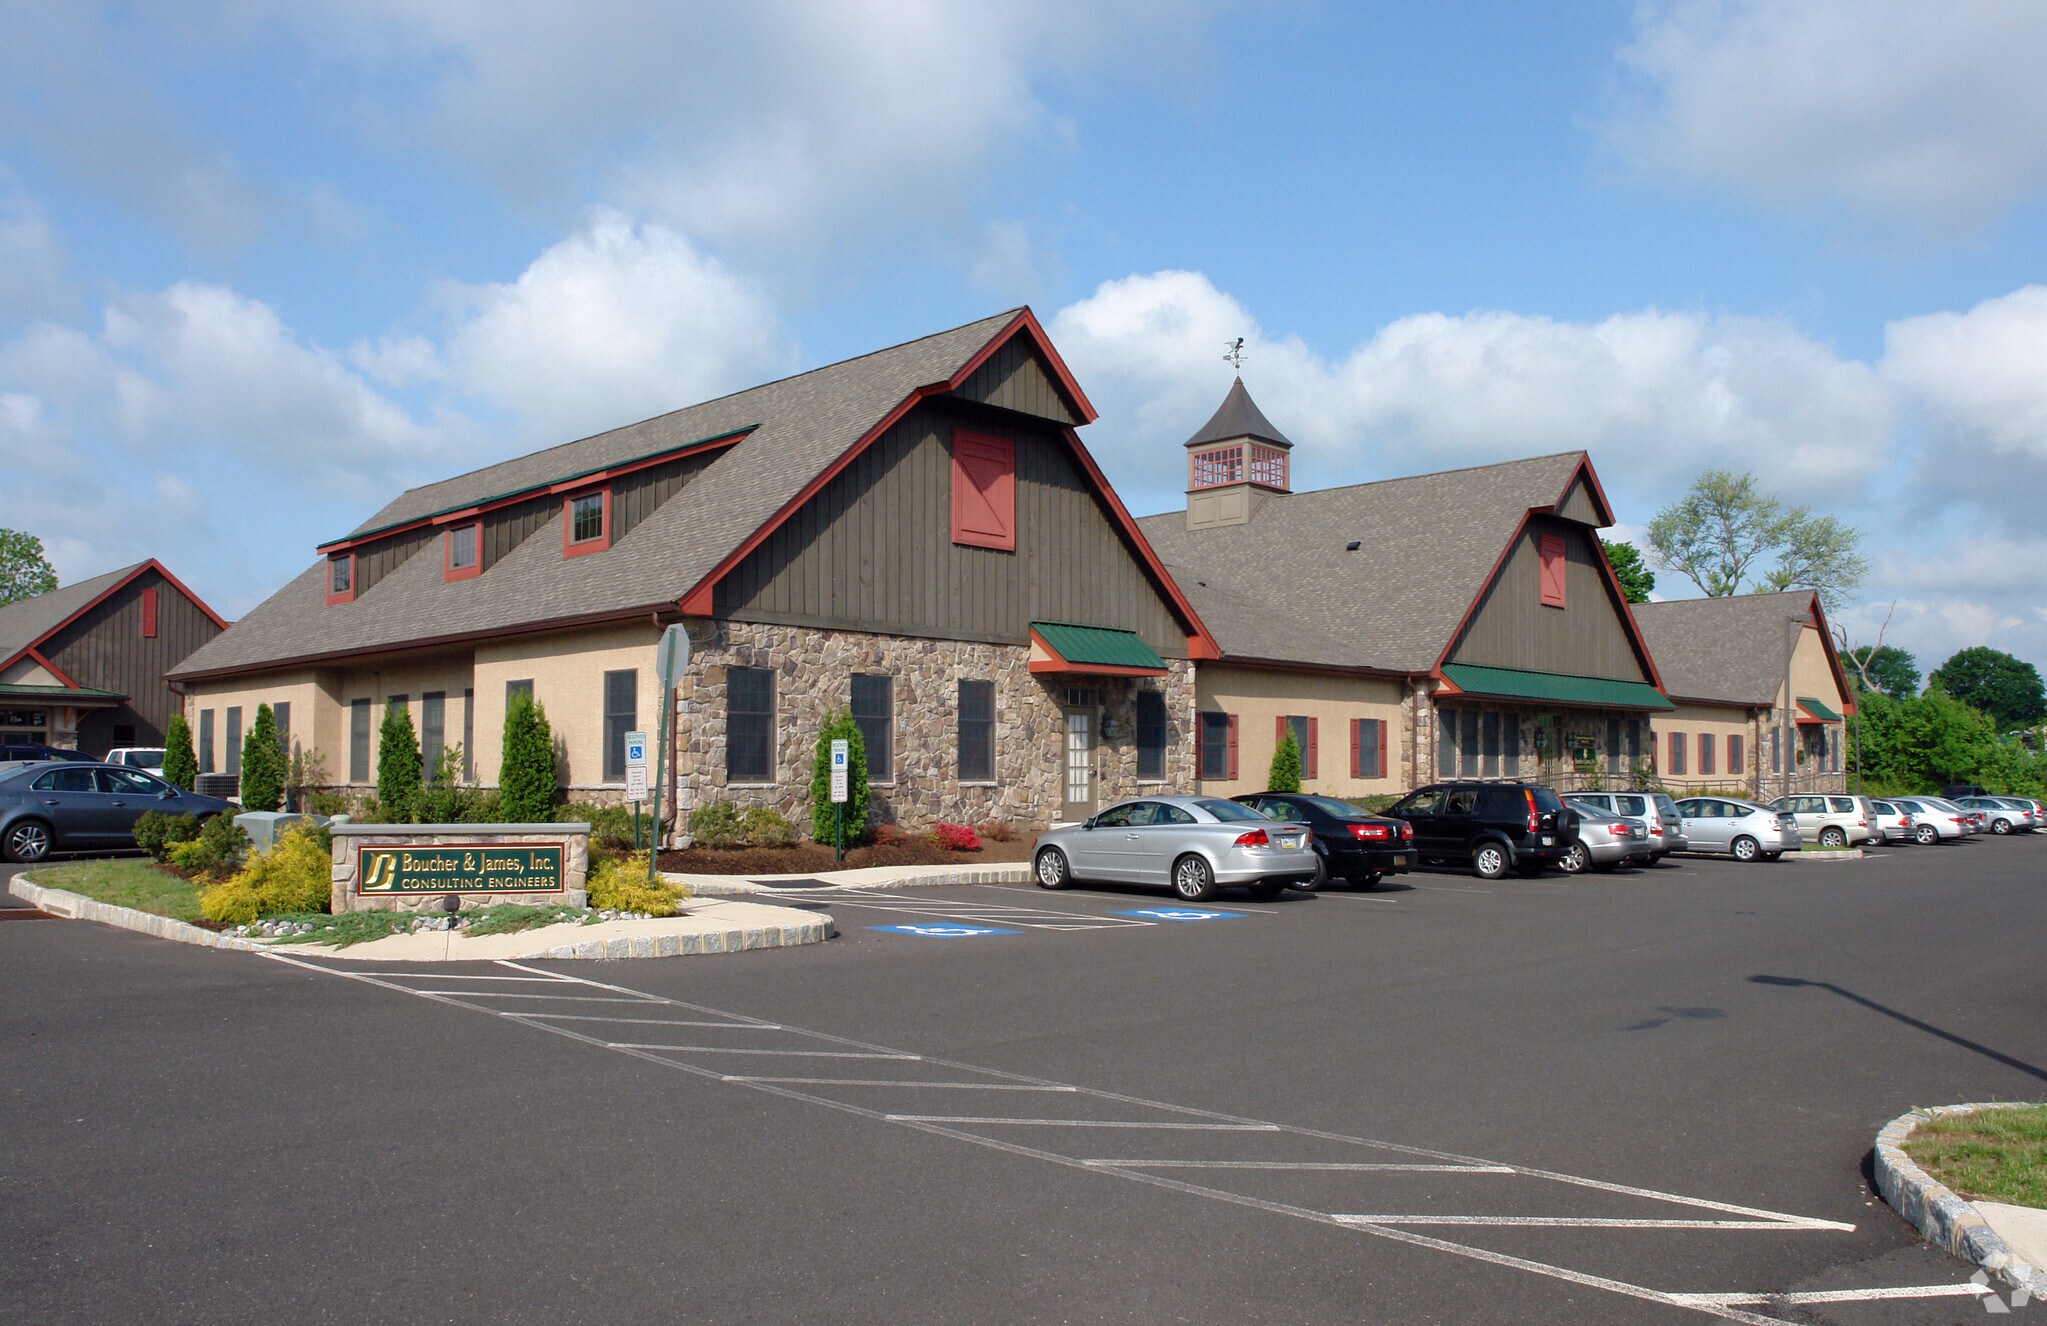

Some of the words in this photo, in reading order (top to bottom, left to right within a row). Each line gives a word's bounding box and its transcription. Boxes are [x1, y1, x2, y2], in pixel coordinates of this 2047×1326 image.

[402, 852, 459, 871] Boucher
[462, 852, 476, 871] &
[478, 852, 525, 874] James,
[529, 851, 554, 870] Inc.
[401, 877, 483, 889] CONSULTING
[487, 876, 556, 889] ENGINEERS
